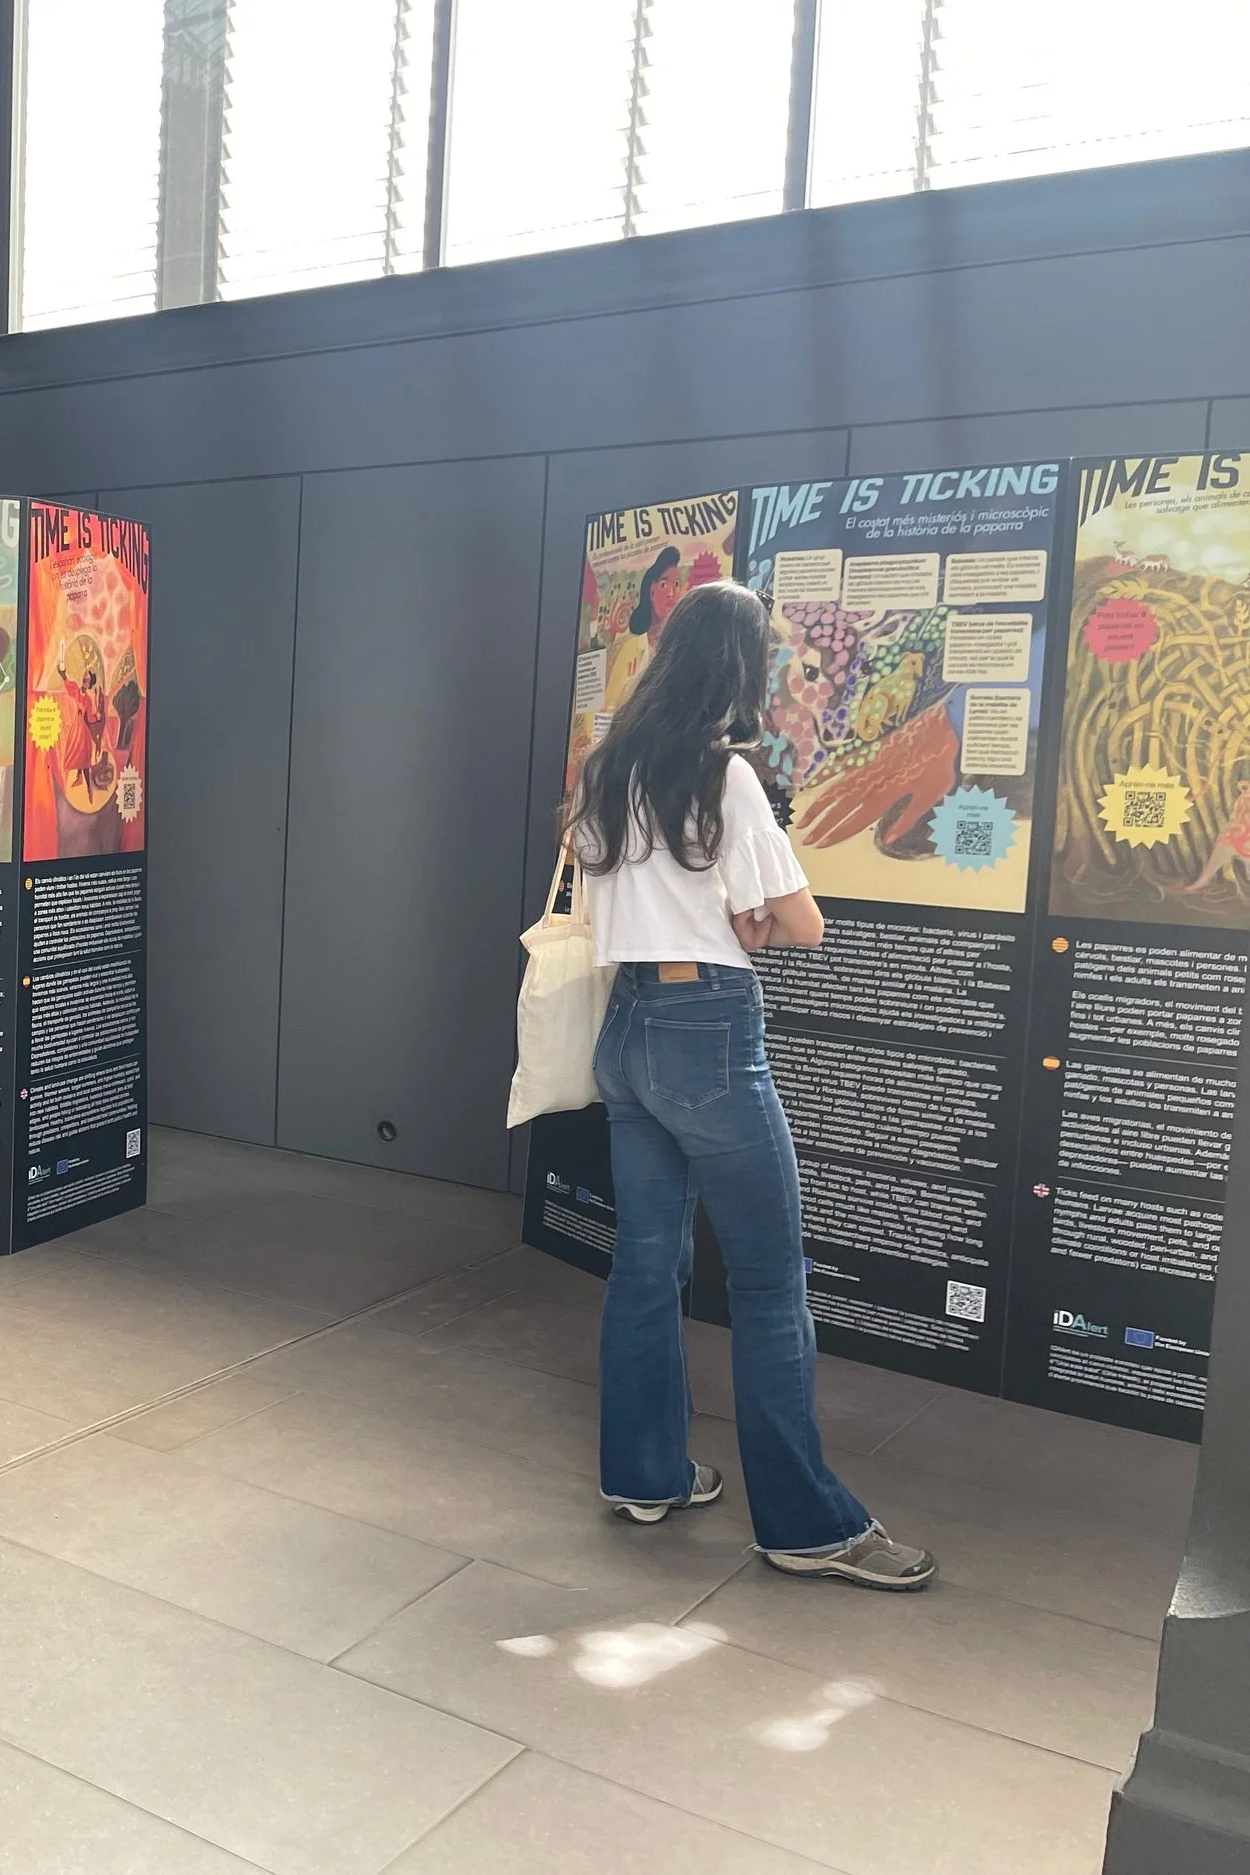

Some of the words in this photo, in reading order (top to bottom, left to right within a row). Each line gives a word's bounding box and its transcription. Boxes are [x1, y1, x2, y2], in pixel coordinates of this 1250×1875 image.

[1197, 454, 1241, 490] IS
[588, 511, 626, 551] TIME
[634, 509, 653, 538] IS
[658, 492, 736, 536] TICKING
[750, 481, 832, 556] TIME
[840, 478, 884, 514] IS
[900, 464, 1059, 504] TICKING
[846, 518, 856, 529] El
[858, 517, 890, 529] costat
[893, 515, 914, 525] més
[918, 512, 966, 524] misteriós
[978, 507, 1049, 522] microscòpic
[866, 528, 880, 539] de
[883, 527, 894, 538] la
[897, 522, 938, 536] història
[941, 524, 957, 534] de
[960, 521, 970, 533] la
[973, 521, 1023, 536] paparra
[31, 508, 70, 563] TIME
[78, 512, 91, 548] IS
[98, 515, 149, 595] TICKING
[1076, 941, 1092, 949] Les
[1094, 943, 1133, 952] paparres
[1149, 948, 1177, 956] poden
[1180, 949, 1222, 960] alimentar
[1224, 953, 1236, 961] de
[1055, 1187, 1078, 1197] Ticks
[1080, 1191, 1099, 1201] feed
[1114, 1199, 1139, 1209] many
[1140, 1202, 1164, 1211] hosts
[1167, 1207, 1188, 1215] such
[1053, 1309, 1108, 1335] iDAlert
